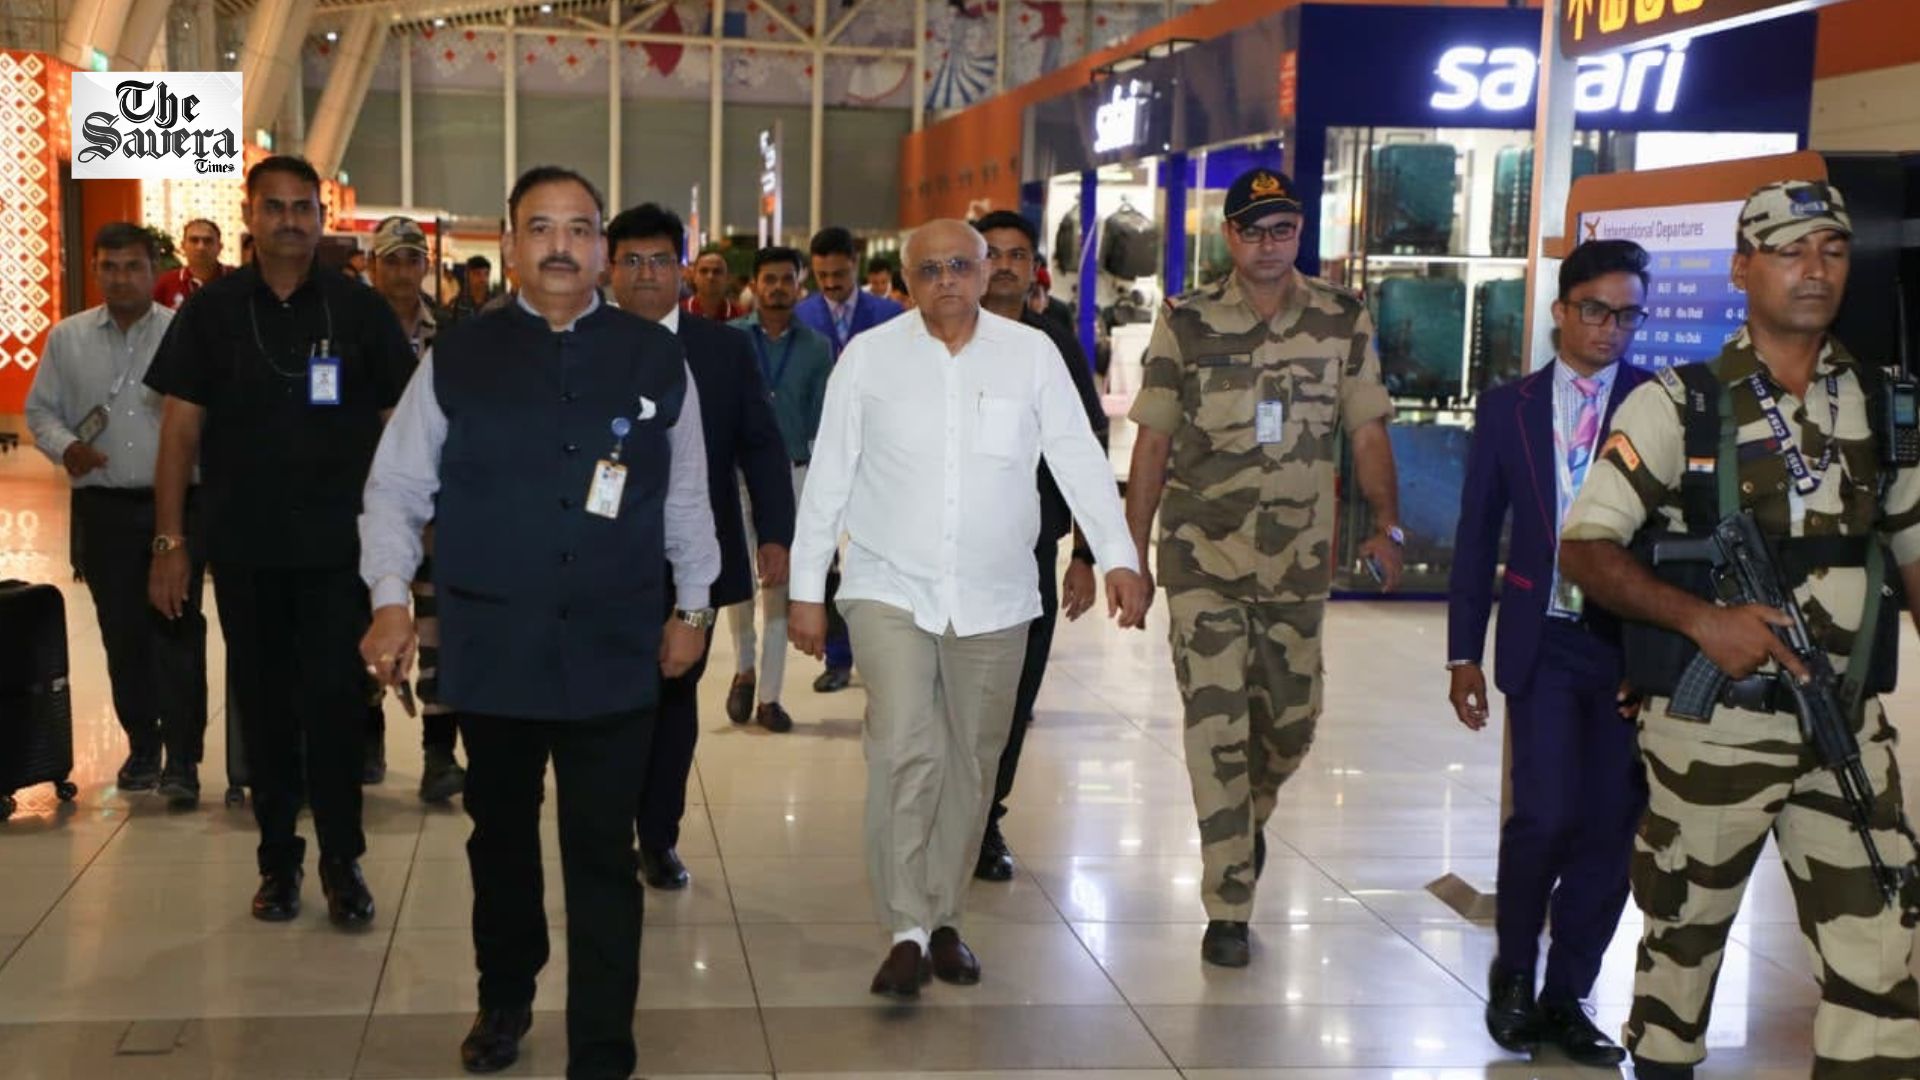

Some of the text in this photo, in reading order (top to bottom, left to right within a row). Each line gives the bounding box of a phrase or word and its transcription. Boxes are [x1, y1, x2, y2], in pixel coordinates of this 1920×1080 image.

[1431, 38, 1691, 112] saari
[1603, 220, 1704, 241] International Departures
